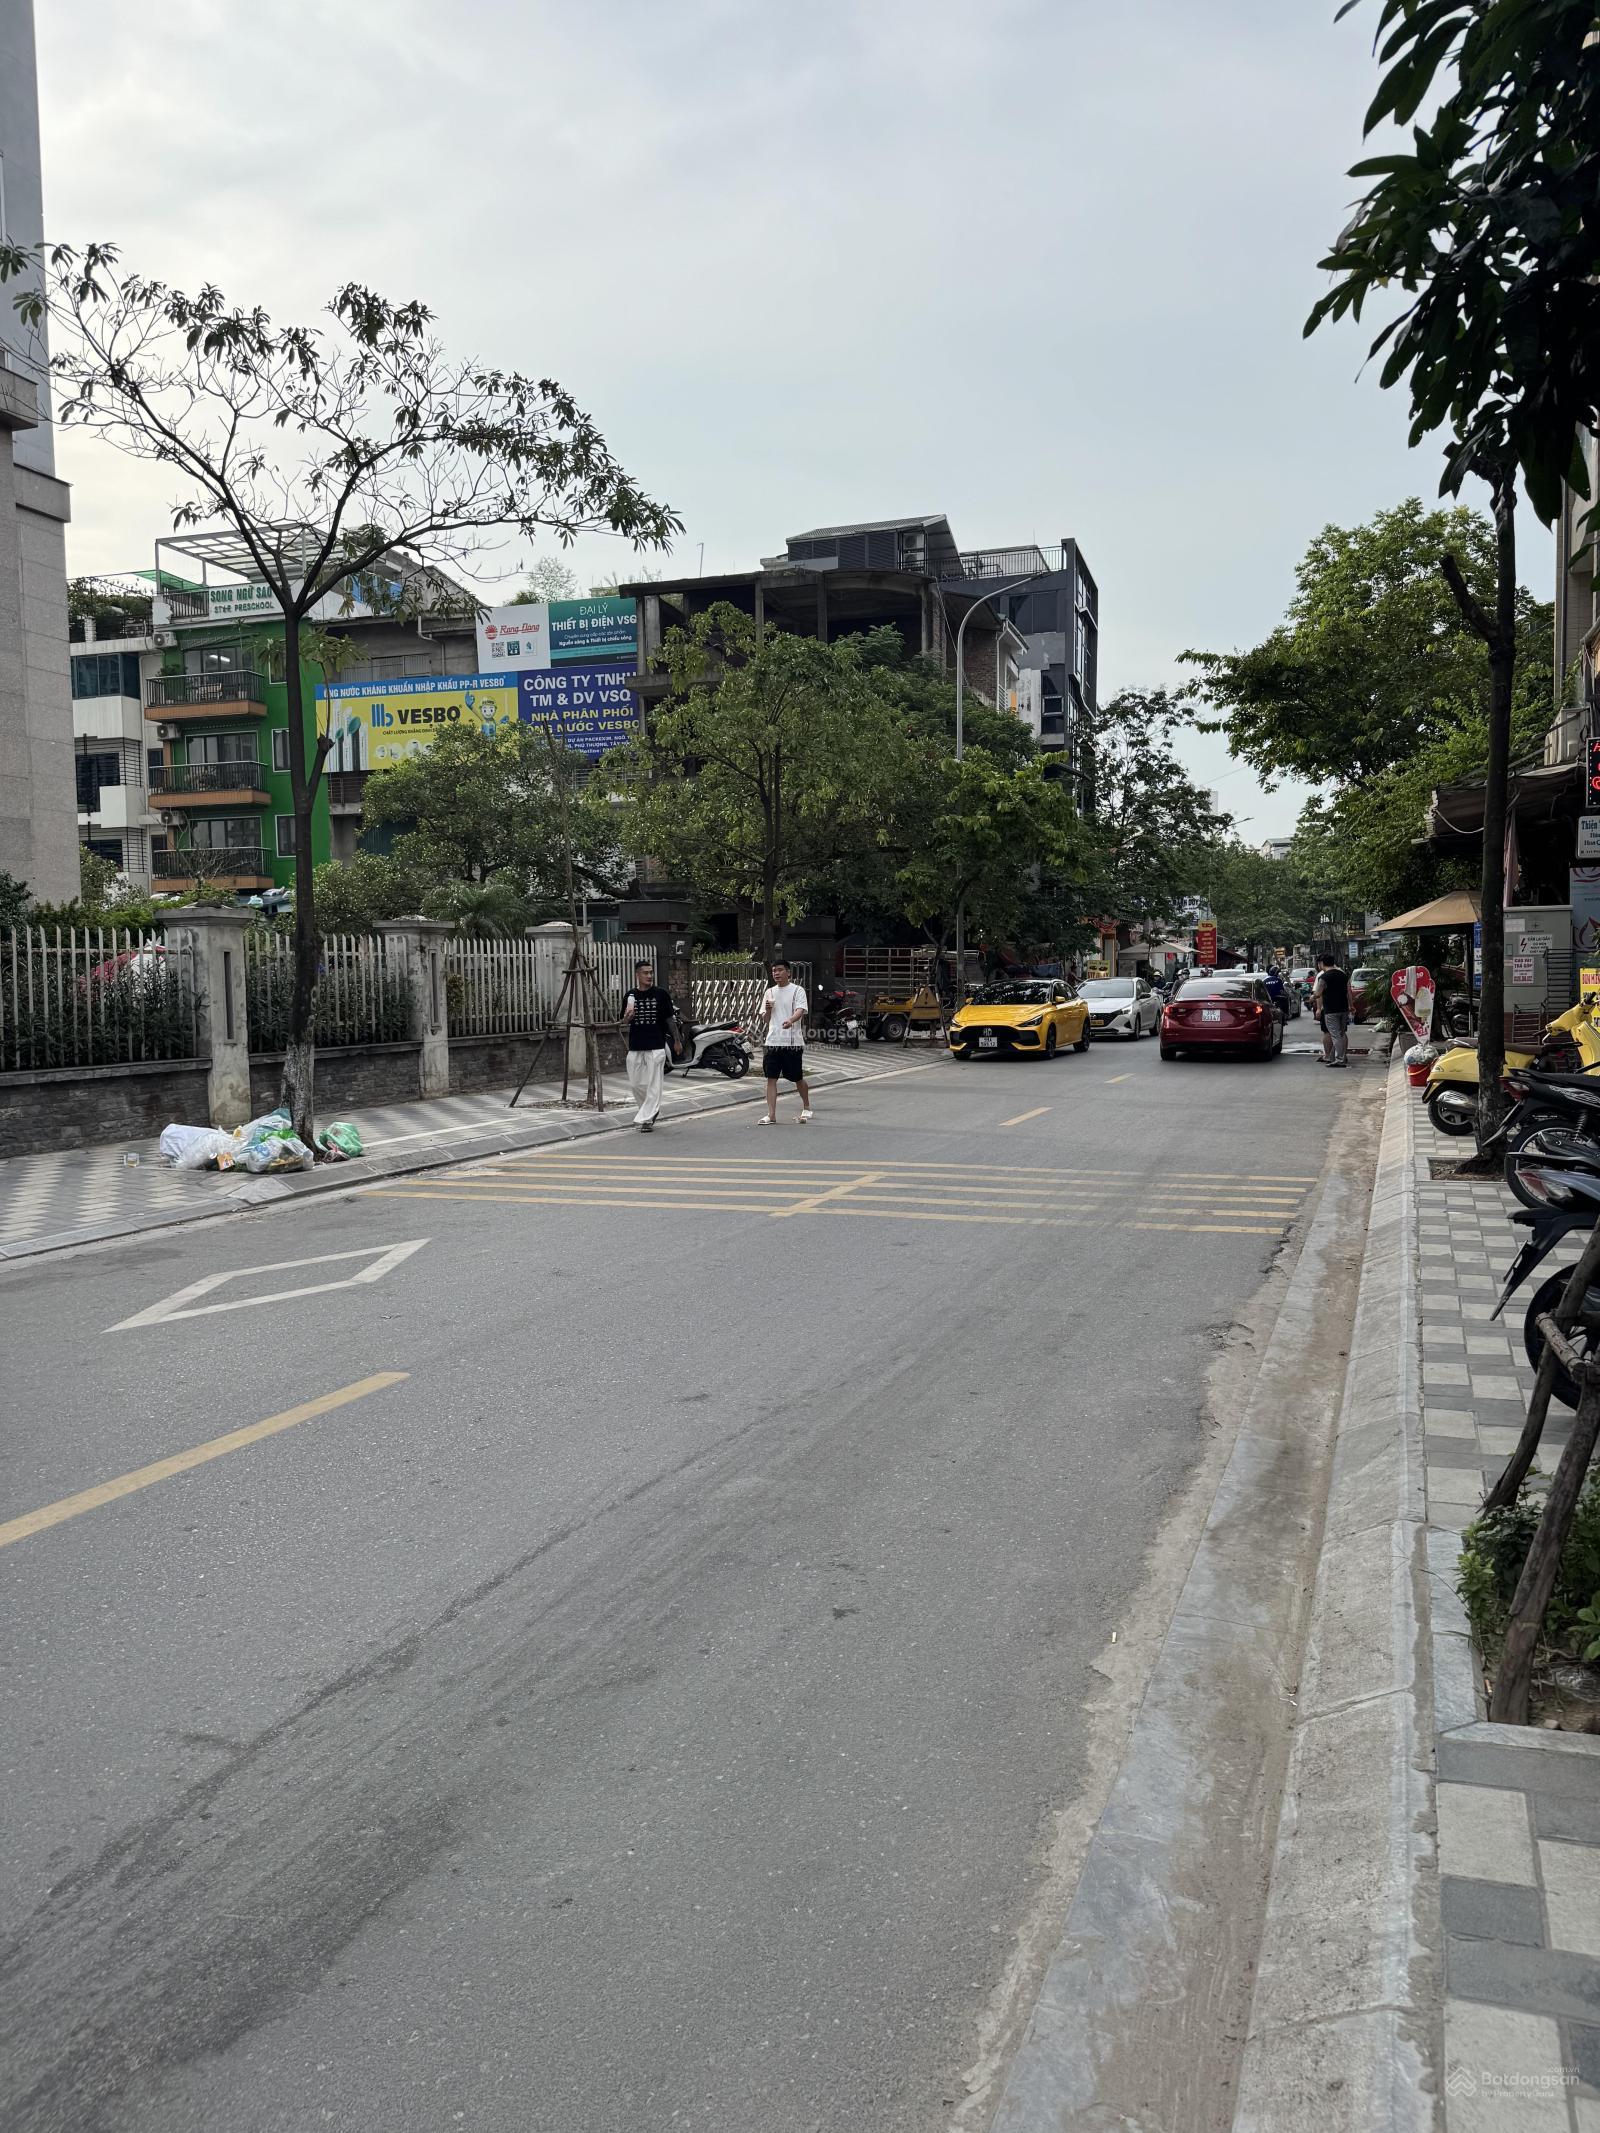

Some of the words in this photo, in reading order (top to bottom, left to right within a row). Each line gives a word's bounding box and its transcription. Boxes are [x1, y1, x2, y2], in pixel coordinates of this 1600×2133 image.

[210, 590, 233, 603] SONG
[256, 586, 273, 599] SAO
[235, 601, 274, 611] PRESCHOOL
[579, 606, 596, 617] ĐẠI
[598, 602, 608, 614] LÝ
[552, 617, 577, 632] THIẾT
[579, 619, 589, 631] BỊ
[591, 616, 614, 629] ĐIỆN
[340, 685, 360, 697] NƯỚC
[415, 681, 436, 694] NHẬP
[437, 678, 458, 691] KHẨU
[459, 680, 478, 690] PP-R
[480, 678, 504, 688] VESBO
[524, 675, 567, 691] CÔNG
[571, 675, 591, 688] TY
[595, 672, 637, 687] TNH
[530, 695, 552, 707] TM
[557, 693, 568, 705] &
[573, 691, 595, 704] DV
[599, 689, 631, 703] VSQ
[398, 705, 461, 725] VESBO
[531, 710, 559, 721] NHÀ
[563, 708, 599, 719] PHÂN
[603, 704, 634, 718] PHỐI
[557, 721, 594, 732] NƯỚC
[598, 720, 639, 731] VESBO
